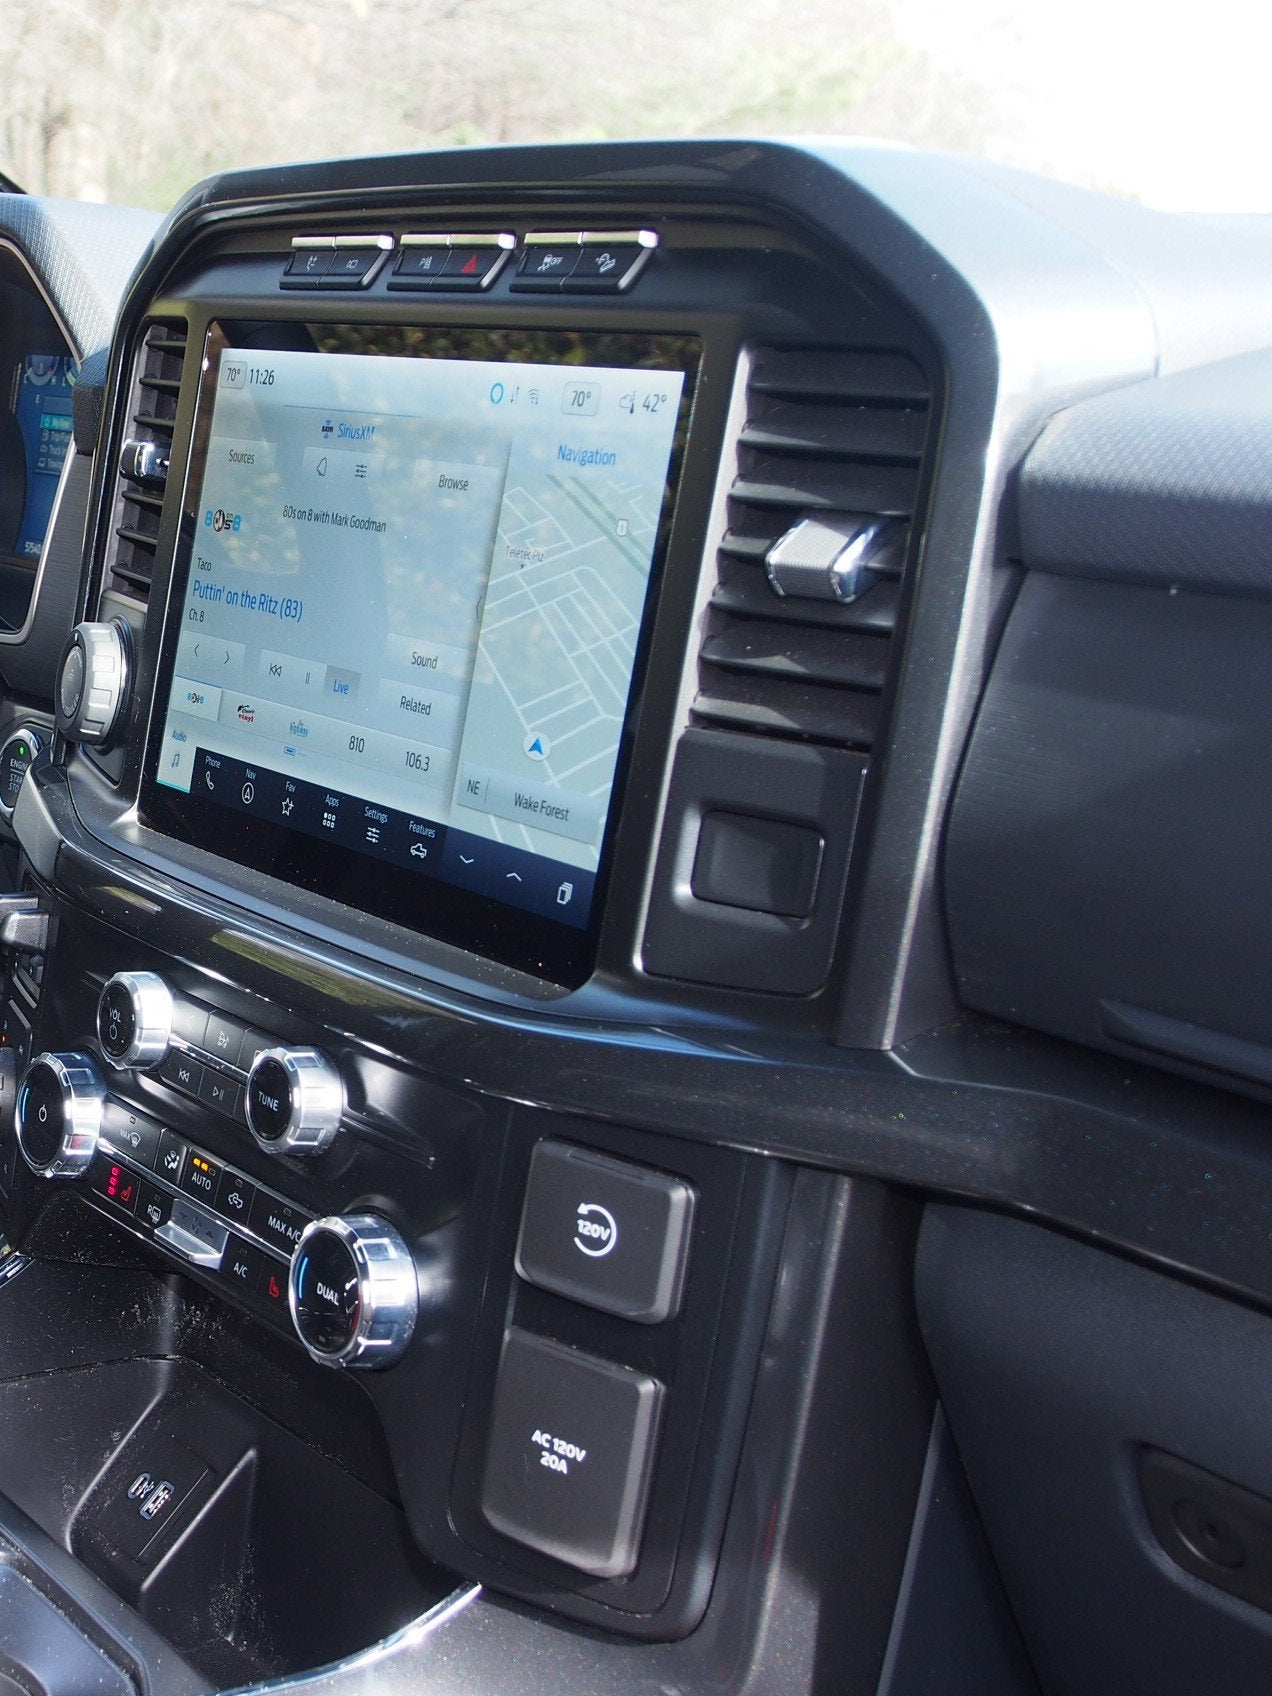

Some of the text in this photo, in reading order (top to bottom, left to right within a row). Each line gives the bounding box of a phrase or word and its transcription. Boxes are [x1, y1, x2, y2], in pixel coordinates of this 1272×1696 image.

[249, 368, 275, 386] 11:26
[571, 390, 592, 407] 70°
[642, 393, 667, 413] 42°
[337, 422, 375, 441] SiriusXM
[228, 449, 255, 465] Sources
[557, 444, 617, 466] Navigation
[438, 474, 469, 491] Browse
[282, 505, 387, 533] 80s on 8 with Mark Goodman
[197, 557, 212, 572] Taco
[192, 579, 303, 622] Puttin' on the Ritz (83)
[188, 607, 205, 622] Ch. 8
[411, 651, 438, 669] Sound
[333, 678, 349, 695] Live
[400, 695, 432, 716] Related
[171, 729, 187, 743] Audio
[348, 735, 365, 754] 810
[205, 755, 221, 769] Phone
[405, 751, 430, 772] 106.3
[245, 768, 257, 780] Nav
[285, 781, 296, 793] Fav
[467, 778, 480, 796] NE
[325, 793, 340, 808] Apps
[514, 791, 570, 822] Wake Forest
[364, 806, 388, 824] Settings
[408, 820, 436, 839] Features
[109, 1007, 122, 1023] VOL
[258, 1090, 279, 1112] TUNE
[191, 1172, 212, 1191] AUTO
[267, 1215, 302, 1244] MAX A/C
[577, 1219, 611, 1241] 120V
[233, 1262, 248, 1278] A/C
[316, 1281, 340, 1306] DUAL
[531, 1429, 587, 1462] AC 120V
[540, 1450, 568, 1475] 20A
